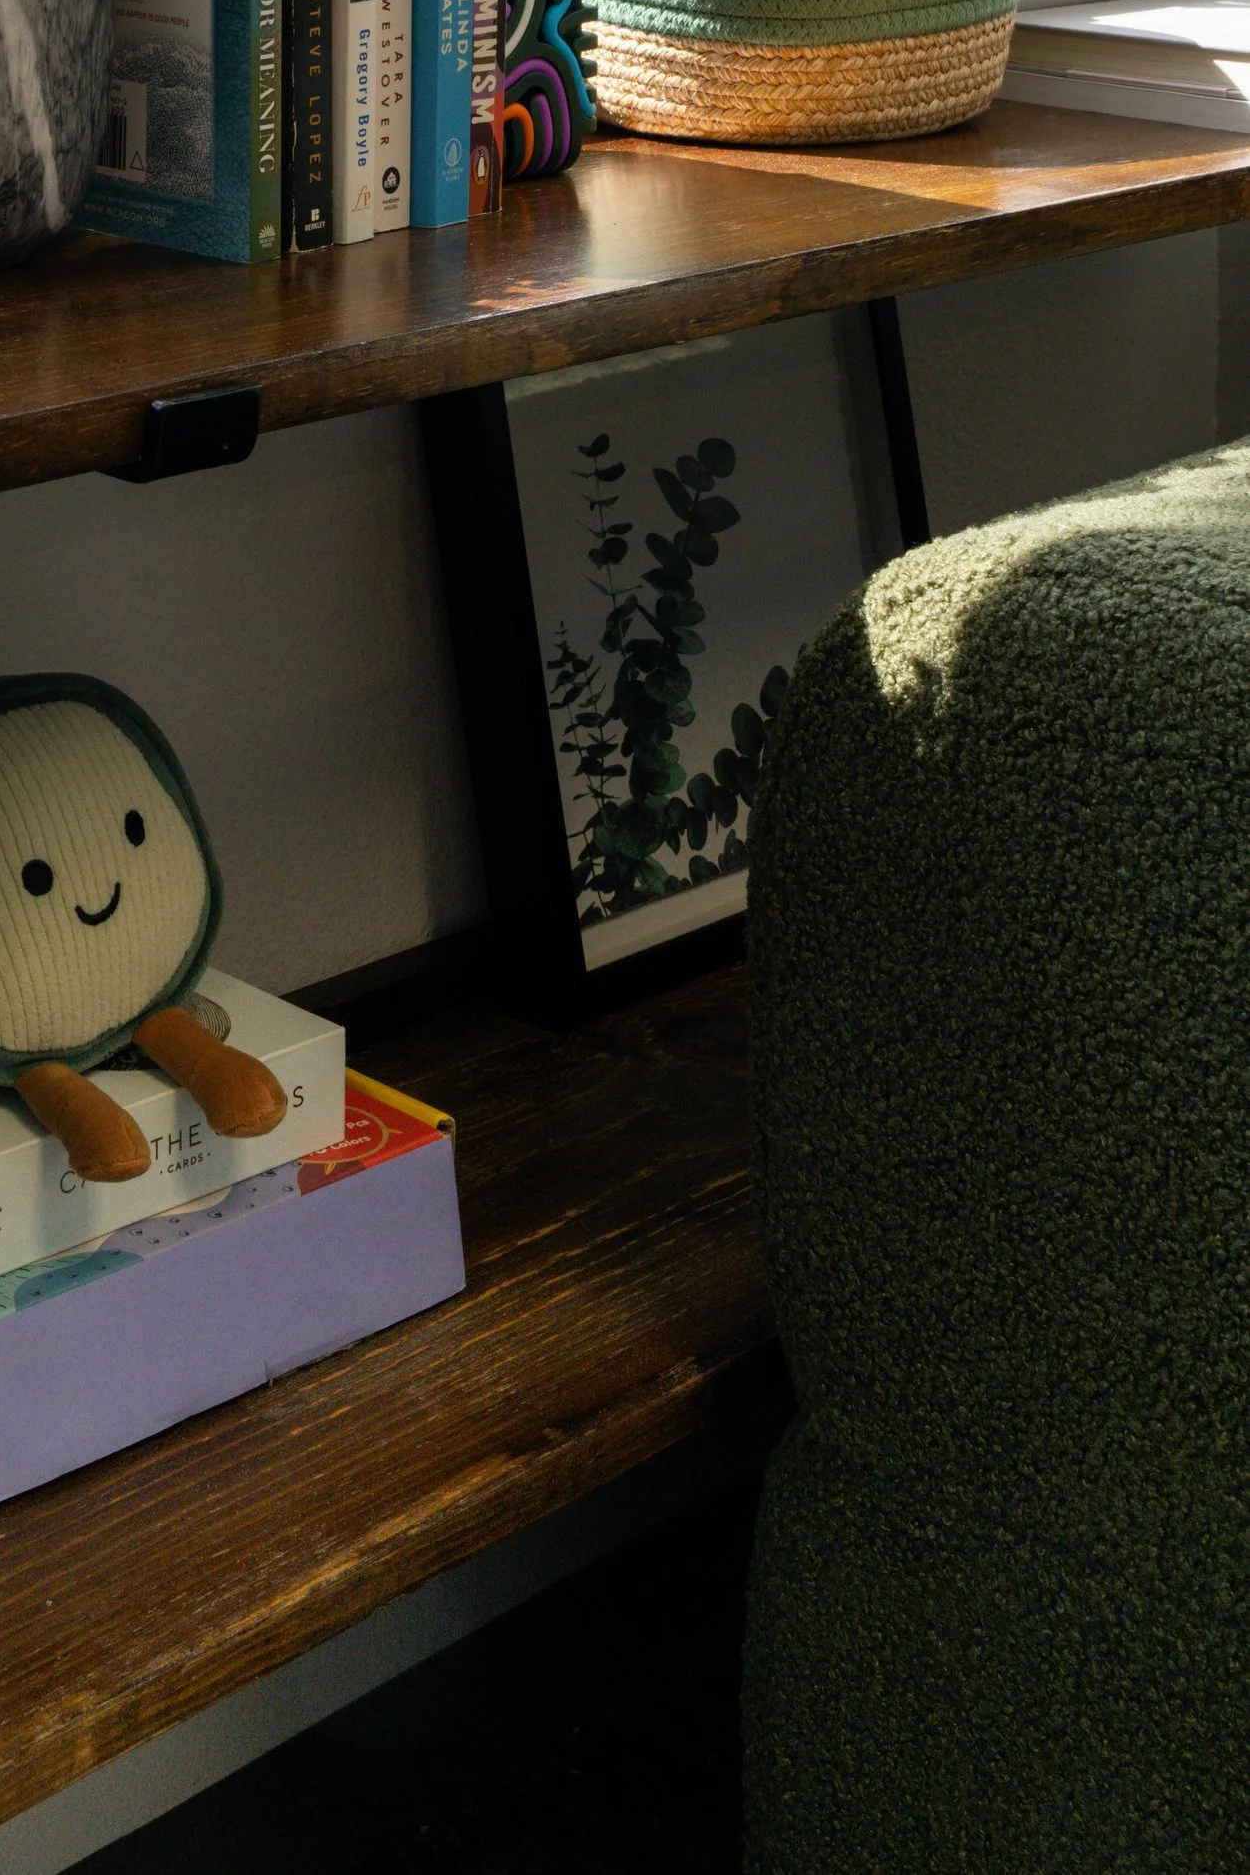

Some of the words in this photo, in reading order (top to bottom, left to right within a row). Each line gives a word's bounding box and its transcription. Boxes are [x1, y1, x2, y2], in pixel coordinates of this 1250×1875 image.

[155, 13, 169, 24] GOOD
[170, 16, 189, 28] PEOPLE
[356, 29, 371, 105] Gregory
[394, 34, 404, 104] TARA
[258, 39, 276, 174] MEANING
[309, 96, 321, 183] LOPEZ
[355, 115, 370, 167] Boyle
[382, 196, 400, 205] RANDOM
[304, 221, 325, 231] BERKLEY
[346, 1118, 370, 1130] Pcs
[150, 1123, 202, 1161] THE
[330, 1135, 371, 1150] Colors
[167, 1153, 205, 1174] CARDS
